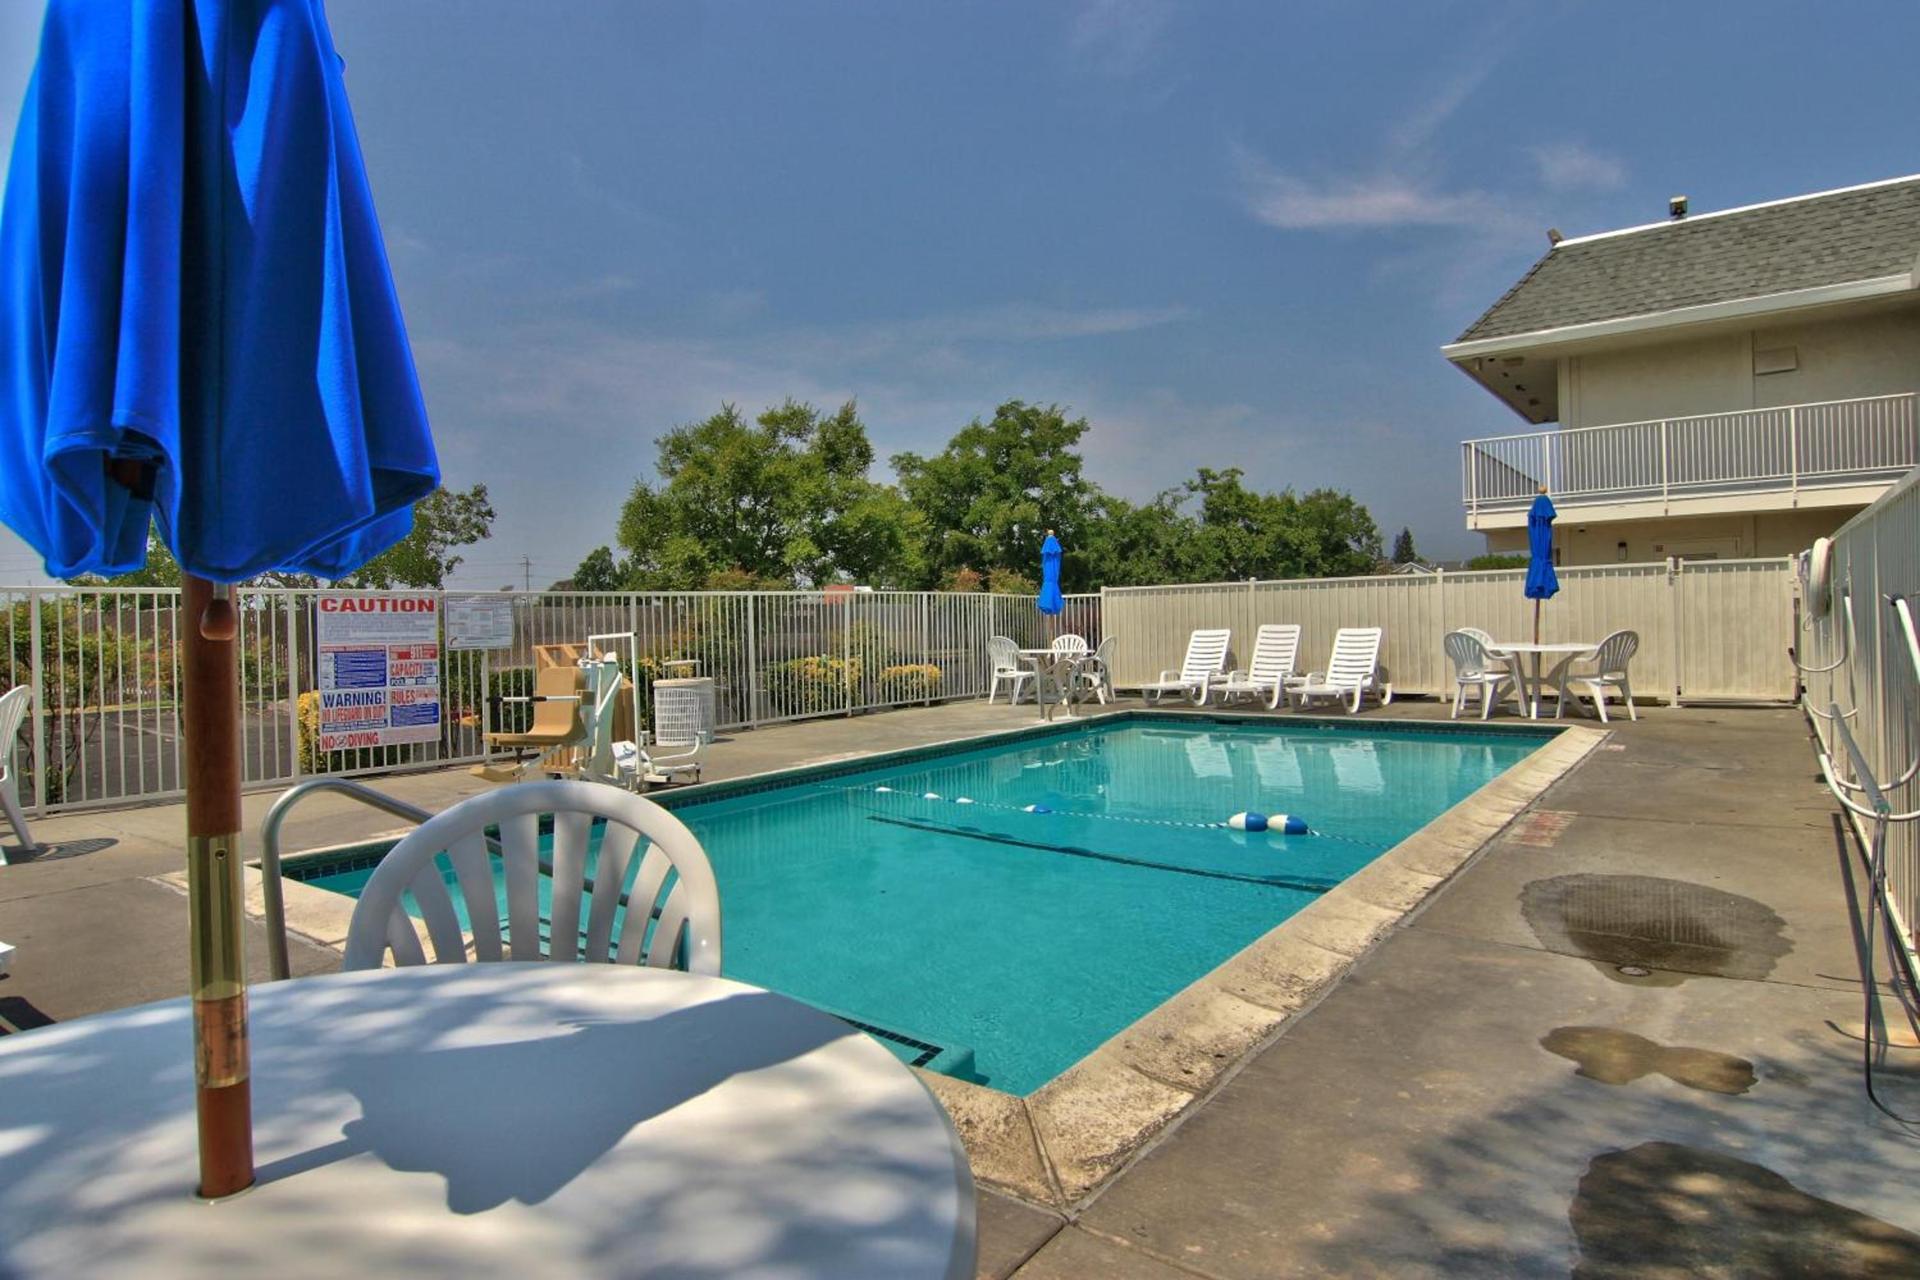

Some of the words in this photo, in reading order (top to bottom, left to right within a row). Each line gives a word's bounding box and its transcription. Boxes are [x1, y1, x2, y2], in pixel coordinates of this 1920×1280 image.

[321, 598, 435, 612] CAUTION
[410, 645, 423, 659] 911
[391, 663, 423, 677] CAPACITY
[322, 691, 386, 708] WARNING!
[391, 689, 416, 704] RULES
[332, 707, 362, 722] LIFEGUARD
[322, 735, 335, 750] NO
[348, 732, 379, 747] DIVING
